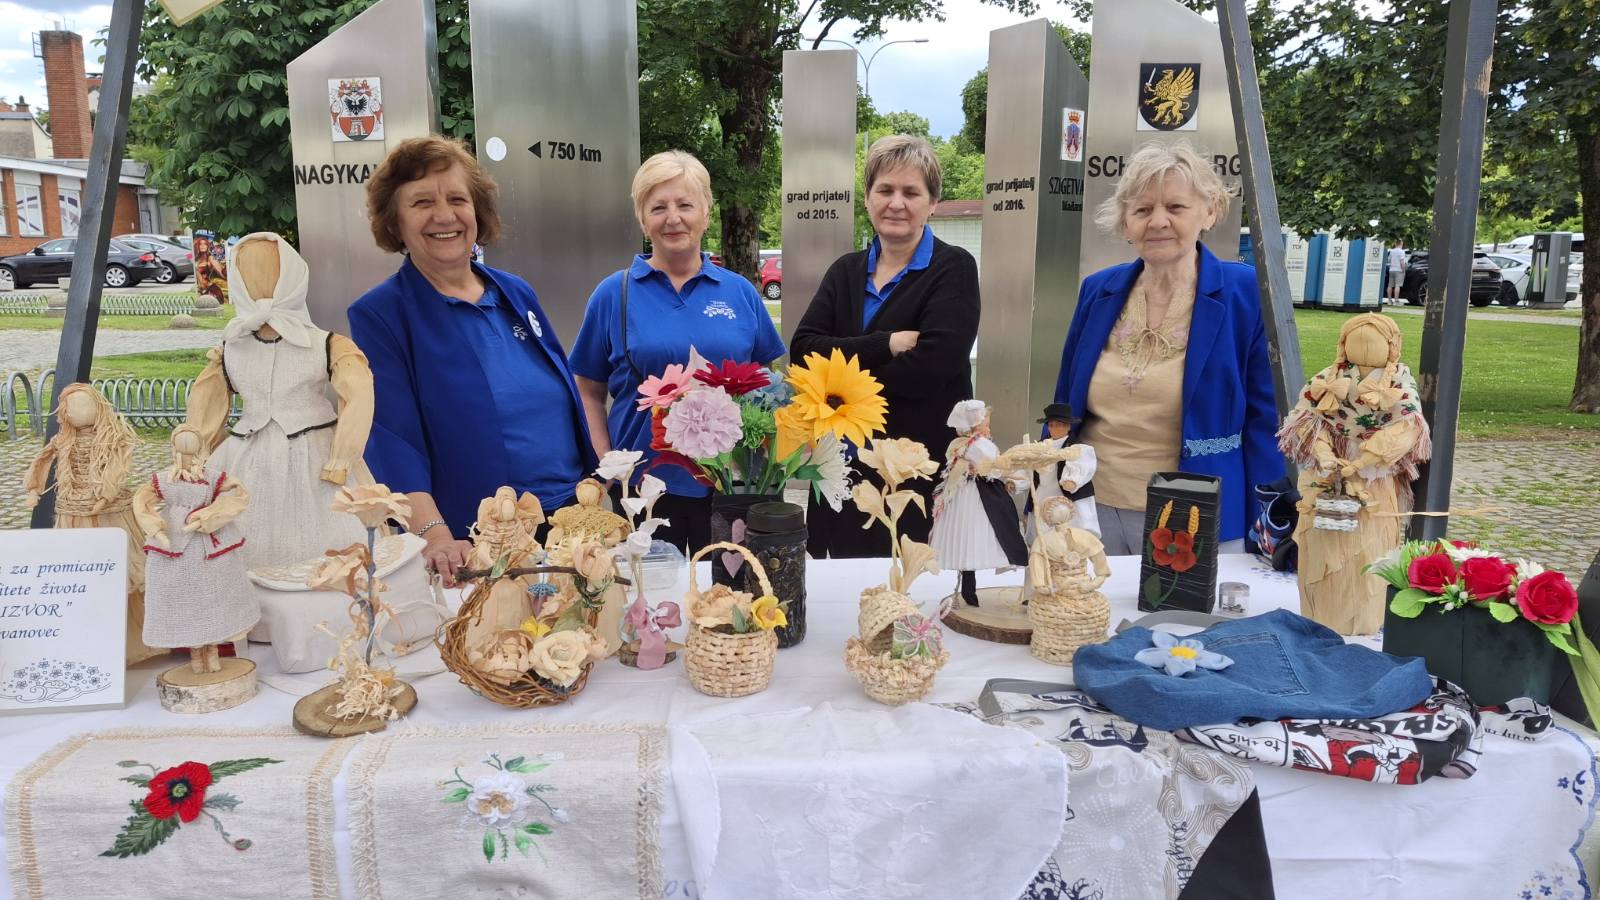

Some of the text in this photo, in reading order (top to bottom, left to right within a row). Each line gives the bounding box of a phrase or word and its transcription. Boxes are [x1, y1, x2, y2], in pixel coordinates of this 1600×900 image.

[547, 141, 602, 162] 750 km
[294, 163, 378, 185] NAGYKA
[986, 176, 1035, 194] grad prijatelj
[787, 190, 850, 203] grad prijatelj
[993, 199, 1025, 211] od 2016.
[797, 209, 839, 220] od 2015.
[10, 559, 116, 578] za promicanje
[40, 582, 87, 595] života
